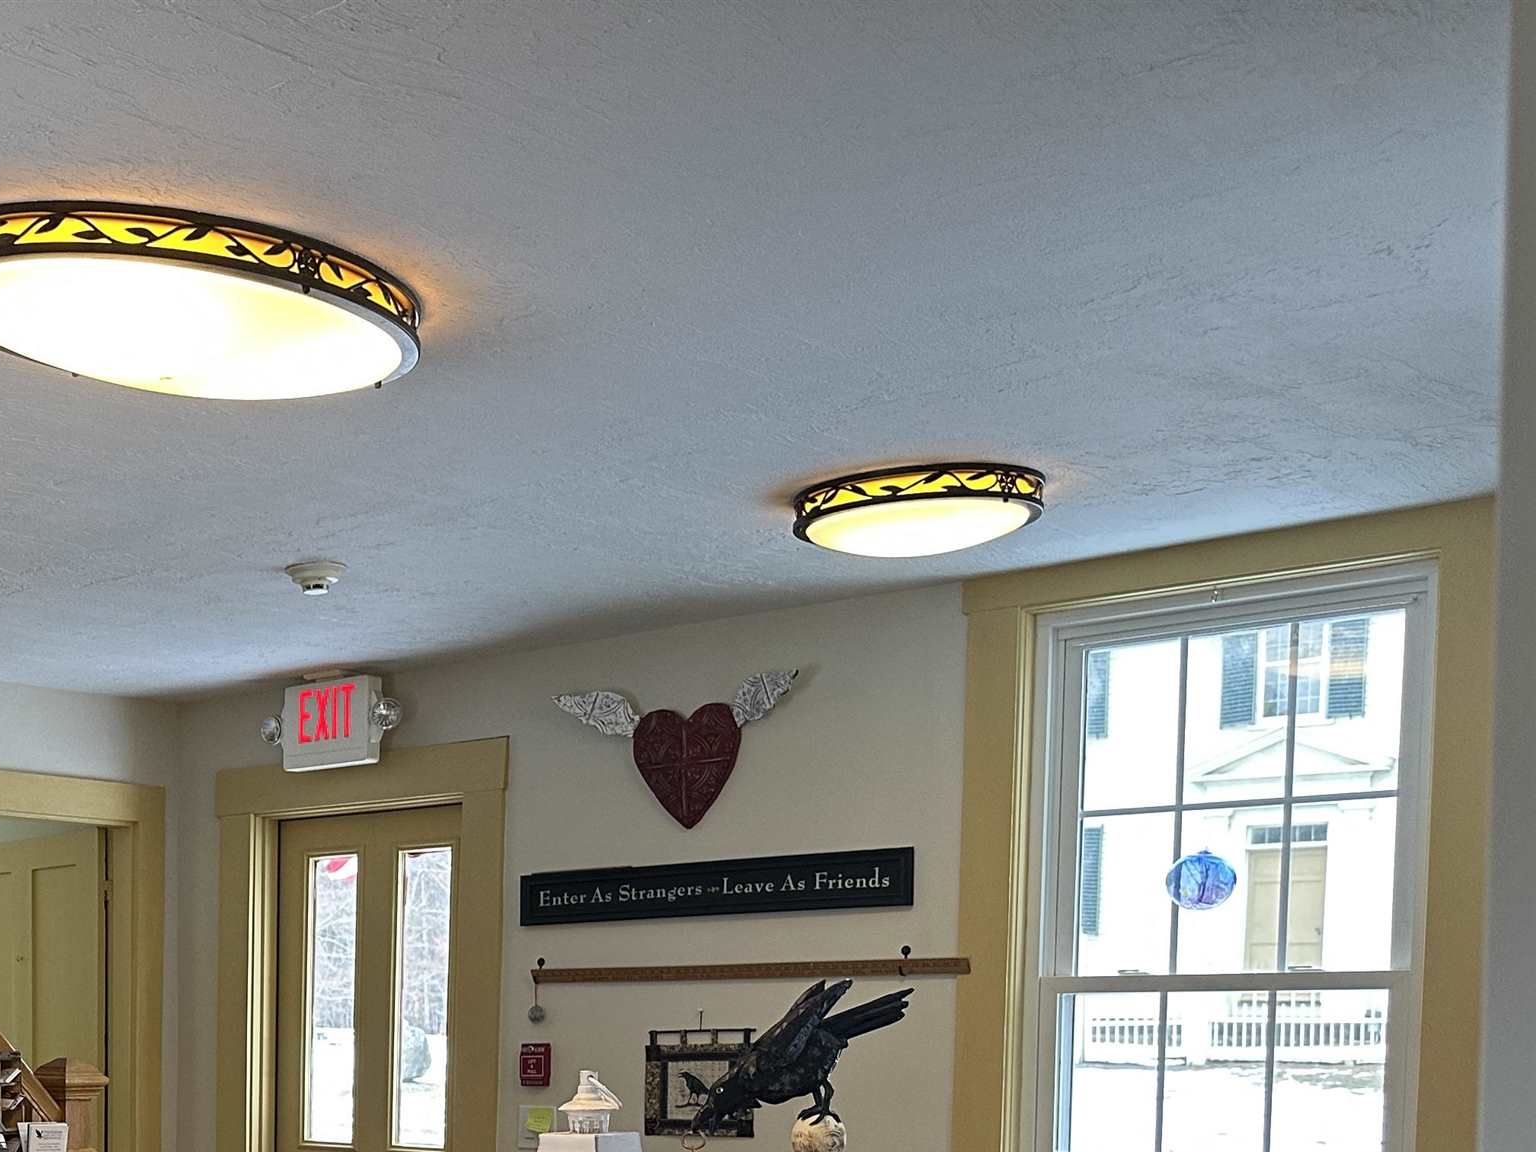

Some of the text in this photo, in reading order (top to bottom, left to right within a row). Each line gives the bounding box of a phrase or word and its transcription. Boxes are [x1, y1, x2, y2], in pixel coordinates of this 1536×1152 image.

[298, 683, 356, 744] EXIT
[539, 867, 891, 907] Enter As Strangers Leave As Friends
